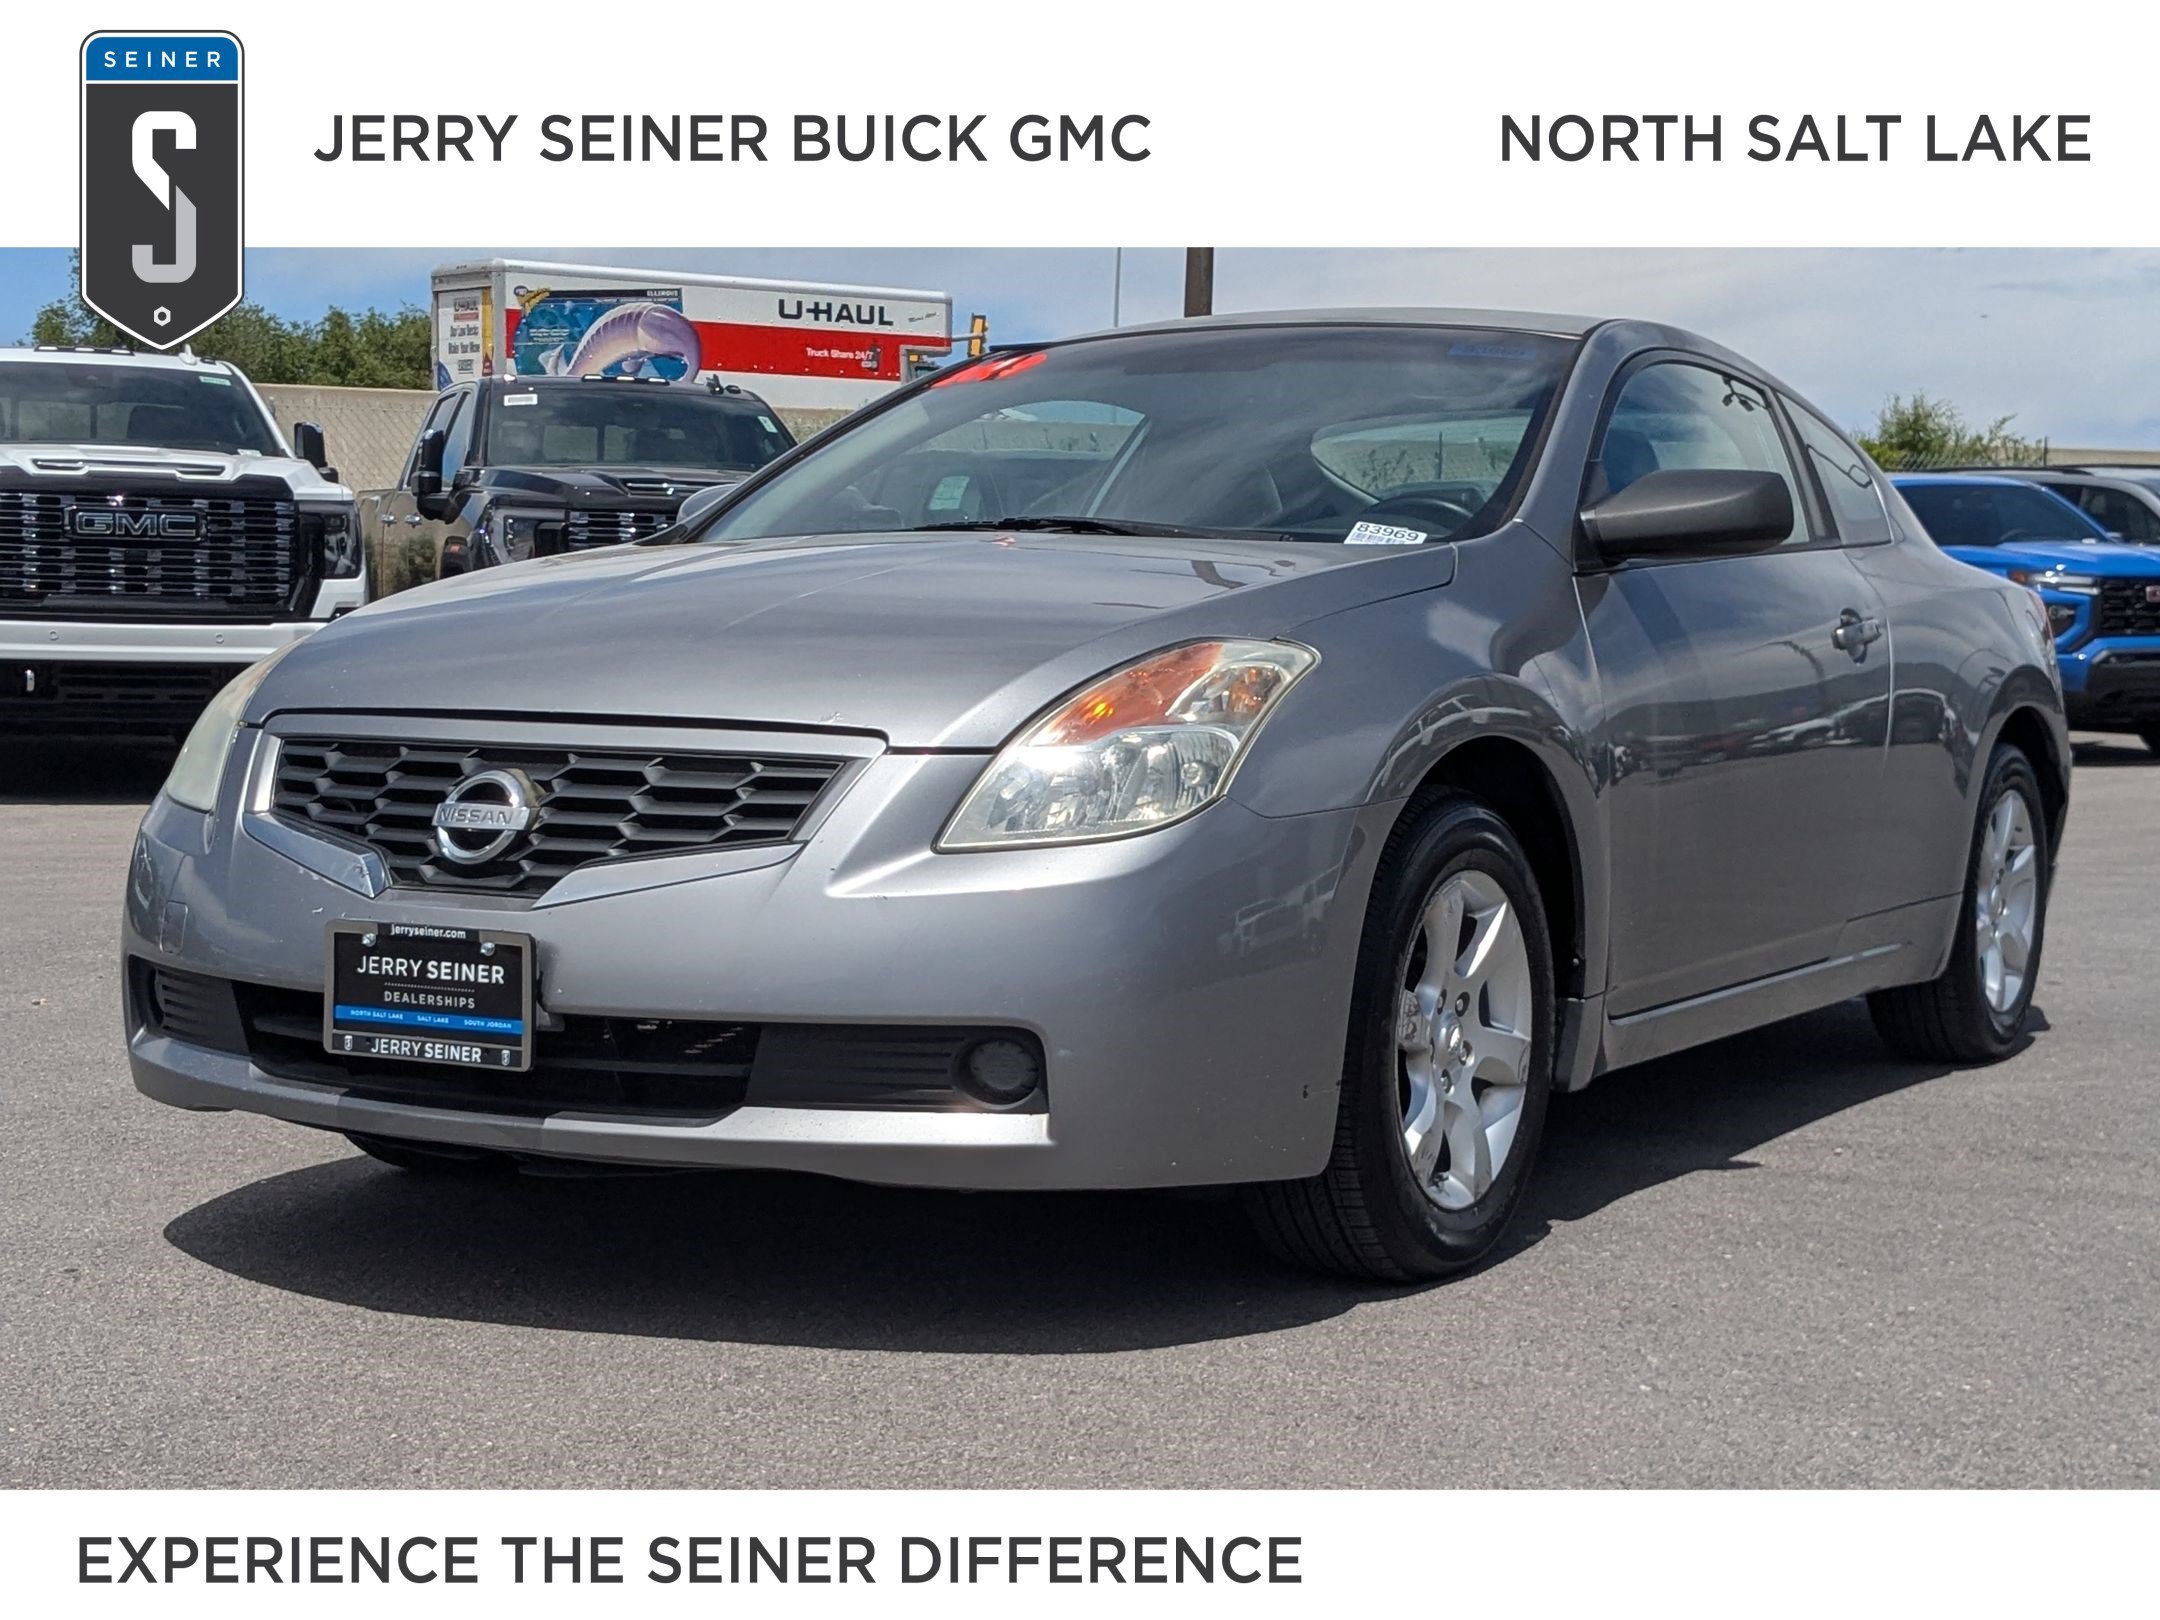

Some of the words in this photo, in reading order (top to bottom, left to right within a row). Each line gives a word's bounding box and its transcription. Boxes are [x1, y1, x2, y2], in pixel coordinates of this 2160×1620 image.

[778, 299, 894, 326] U-HAUL
[806, 347, 829, 358] Truck
[831, 349, 854, 360] Share
[76, 512, 196, 536] GMC
[1356, 523, 1419, 542] 83969
[440, 807, 513, 825] NISSAN
[390, 924, 467, 940] jerryseiner.com
[357, 955, 423, 978] JERRY
[426, 960, 505, 985] SEINER
[384, 990, 476, 1009] DEALERSHIPS
[350, 1009, 372, 1017] NORTH
[372, 1011, 387, 1019] SALT
[433, 1016, 449, 1024] LAKE
[464, 1019, 485, 1027] SOUTH
[486, 1021, 512, 1029] JORDAN
[371, 1038, 422, 1057] JERRY
[424, 1045, 482, 1063] SEINER
